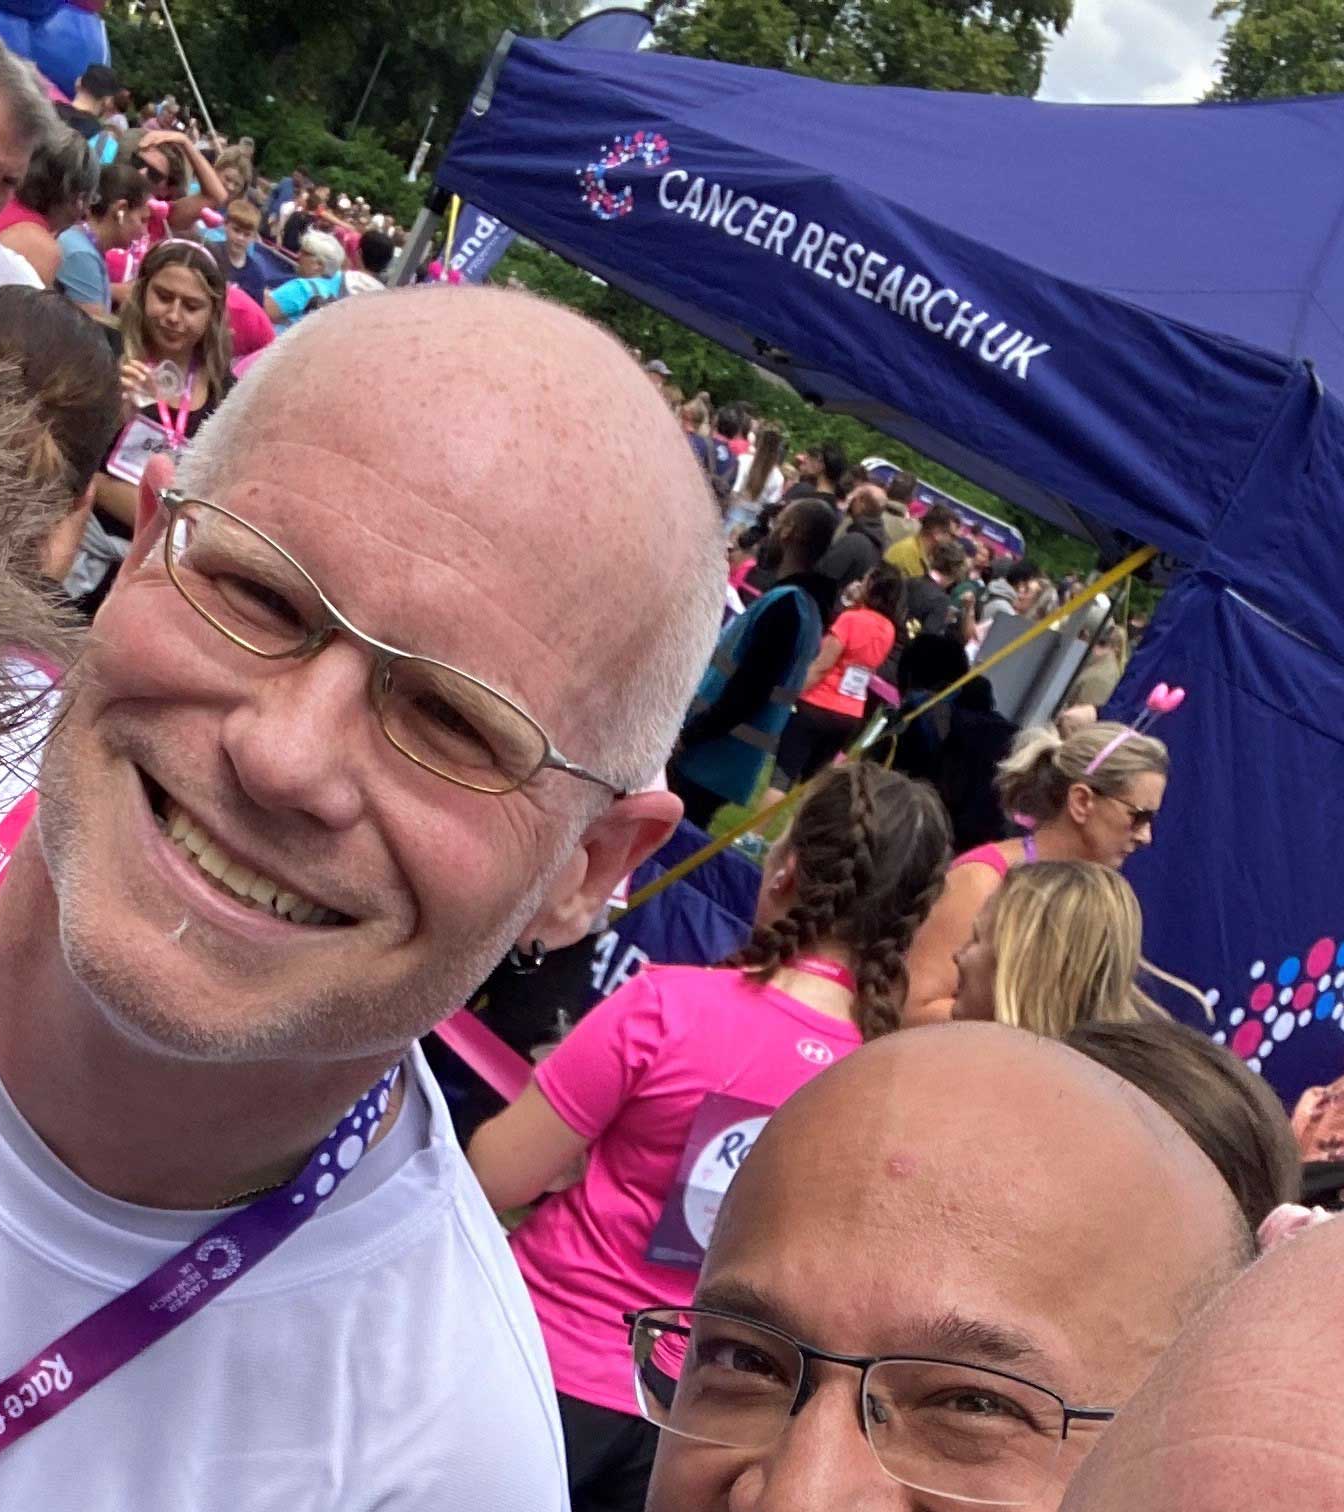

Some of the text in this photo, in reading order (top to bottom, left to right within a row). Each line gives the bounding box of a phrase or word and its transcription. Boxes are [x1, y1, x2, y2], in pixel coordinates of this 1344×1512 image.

[659, 170, 1052, 381] CANCER RESEARCH UK
[5, 1353, 74, 1419] Race
